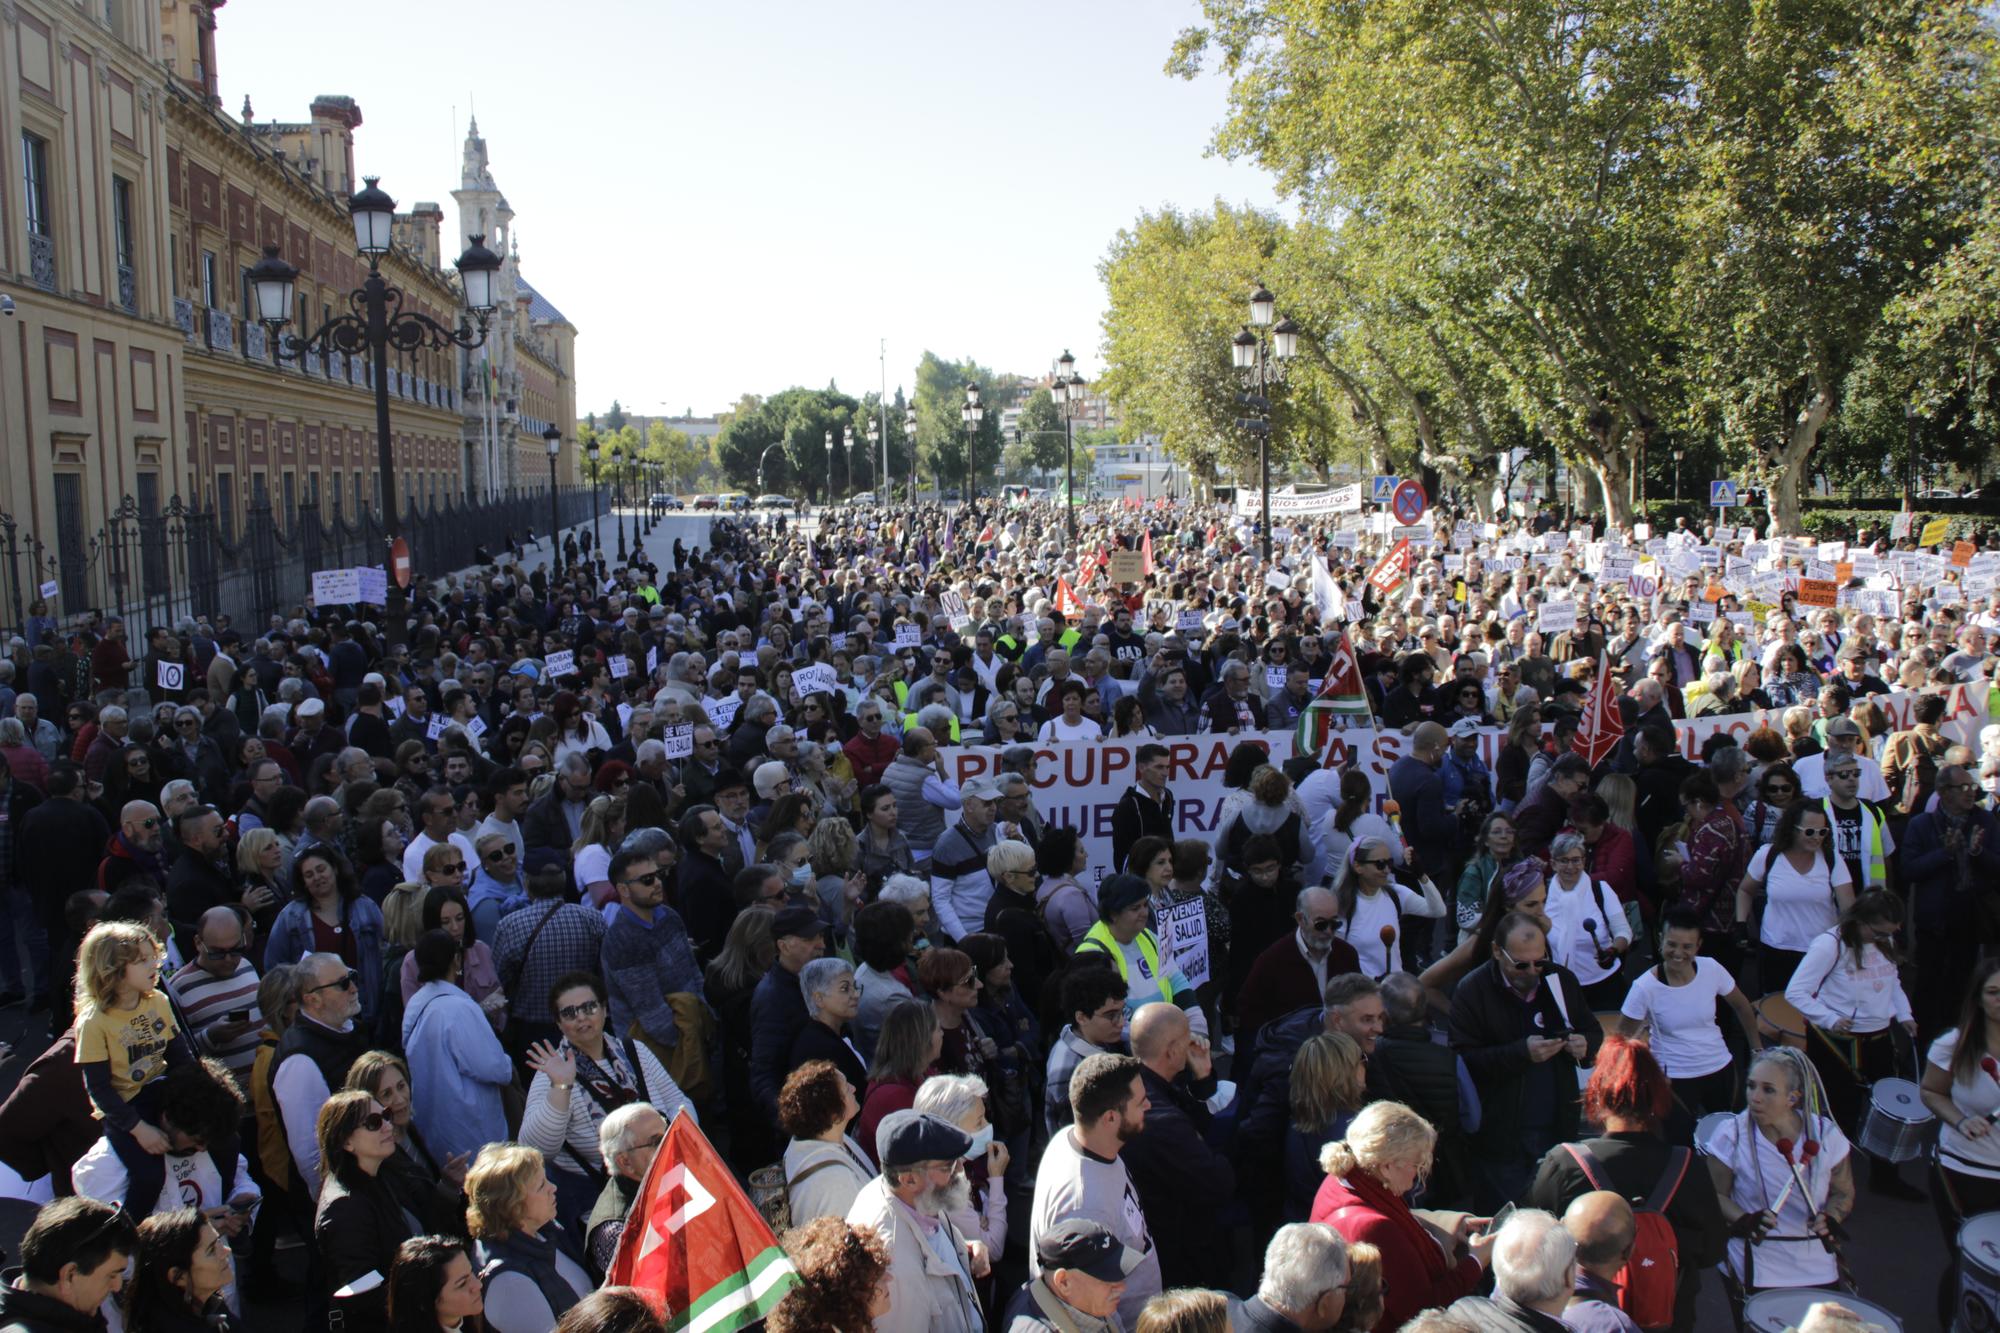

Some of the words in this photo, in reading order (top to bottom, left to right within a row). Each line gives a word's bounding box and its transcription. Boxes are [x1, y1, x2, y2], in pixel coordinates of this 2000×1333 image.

[1246, 498, 1298, 508] BARIOS
[1485, 560, 1503, 571] NO
[1505, 557, 1521, 569] NO
[1627, 576, 1656, 597] NO
[1803, 581, 1837, 592] PEDIMOS
[941, 591, 964, 615] NO
[1811, 594, 1835, 604] JUSTO
[1147, 601, 1173, 621] NO
[1116, 646, 1142, 660] GAP
[548, 662, 571, 674] SALUD
[158, 663, 181, 688] NO
[665, 727, 674, 738] SE
[676, 724, 692, 736] VENDE
[667, 741, 675, 753] TU
[957, 739, 1270, 787] RCUPRA
[1172, 900, 1203, 920] VENDE
[1182, 949, 1207, 982] usticia!
